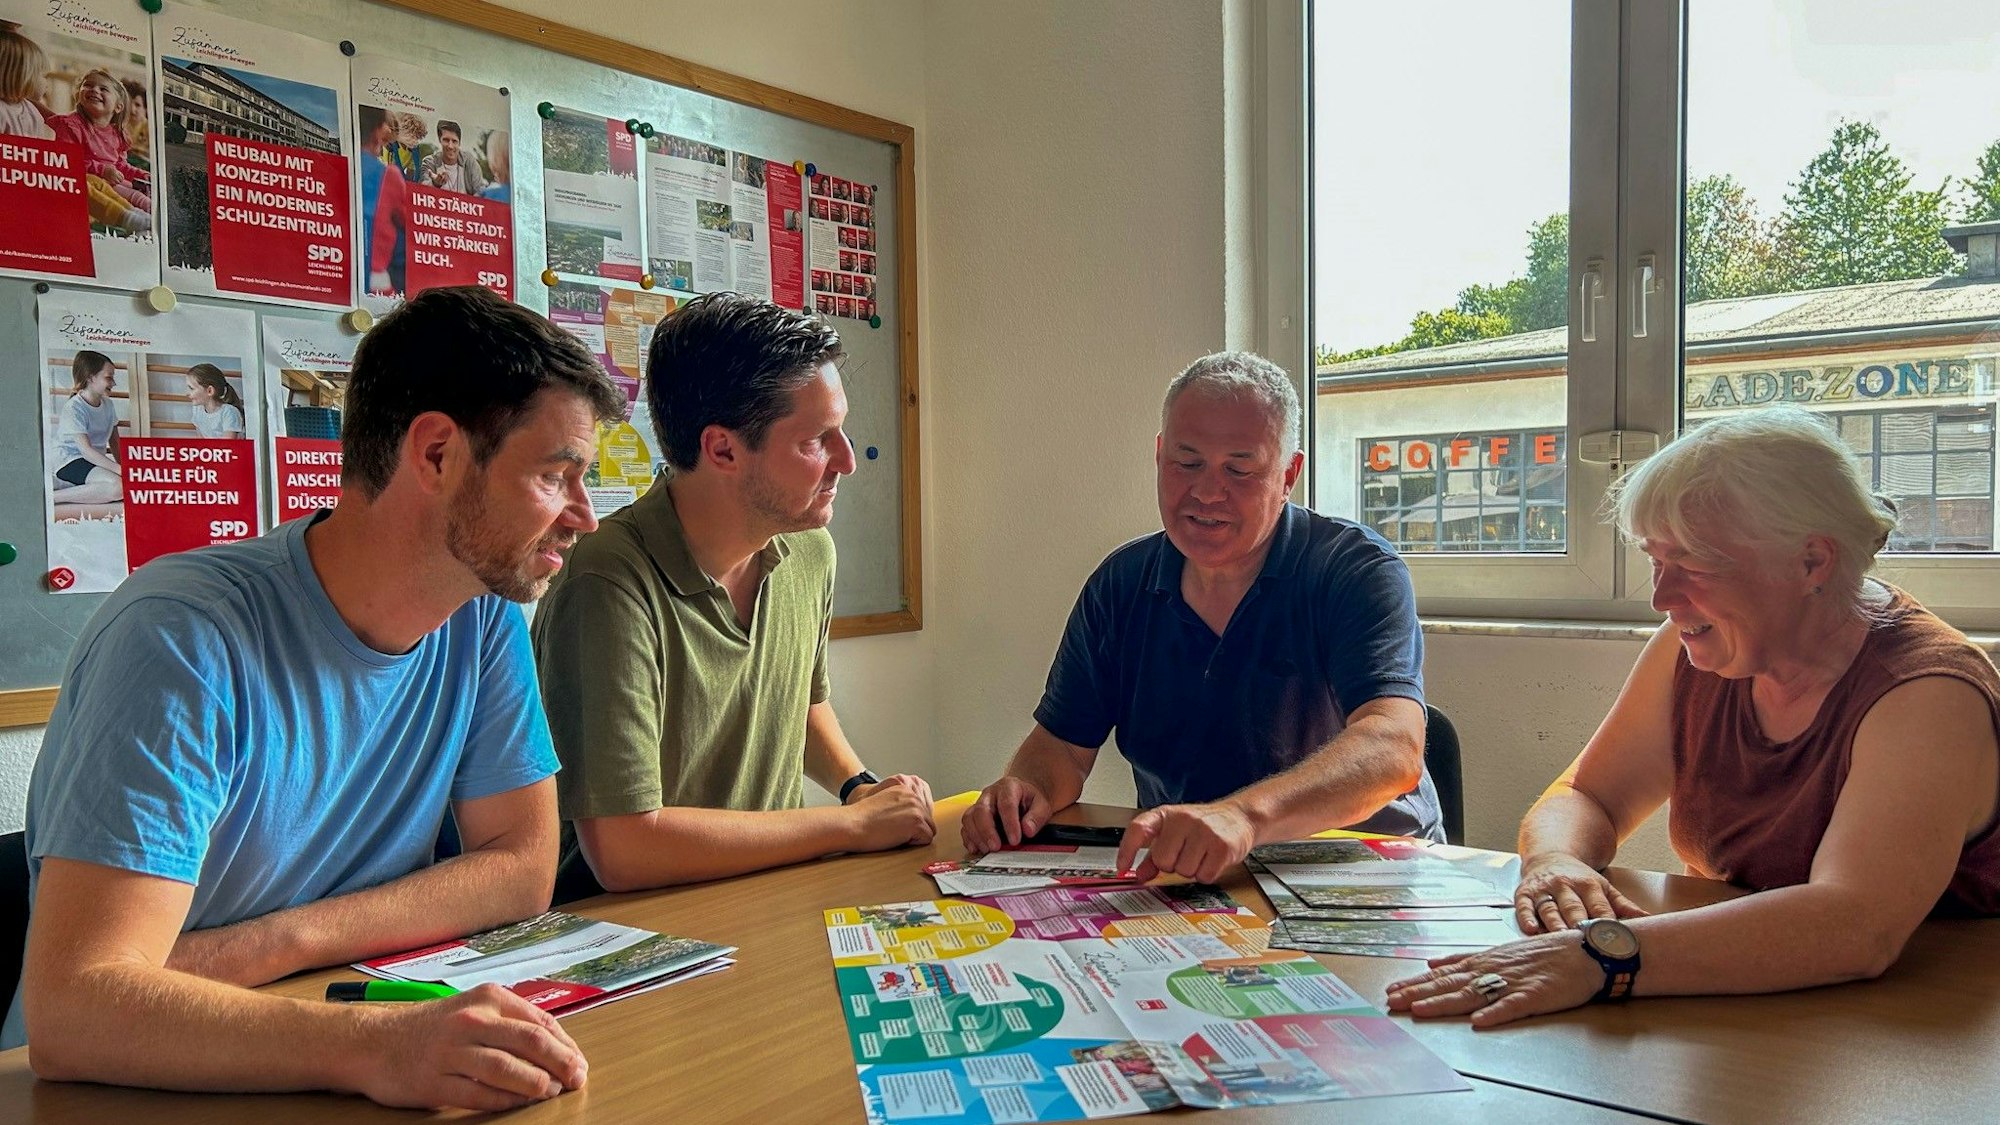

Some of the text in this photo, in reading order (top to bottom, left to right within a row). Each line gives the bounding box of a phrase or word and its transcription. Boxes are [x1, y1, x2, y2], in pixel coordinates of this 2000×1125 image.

[47, 0, 120, 30] Zusammen
[73, 21, 138, 41] Leichlingen bewegen
[172, 27, 240, 56] Zusammen
[367, 77, 423, 102] Zusammen
[615, 131, 632, 143] SPD
[43, 150, 69, 169] IM
[214, 140, 315, 173] NEUBAU MIT
[0, 167, 81, 194] LPUNKT.
[215, 162, 326, 196] KONZEPT! FÜR
[215, 184, 335, 217] EIN MODERNES
[412, 192, 485, 217] IHR STÄRKT
[216, 206, 343, 239] SCHULZENTRUM
[413, 212, 507, 239] UNSERE STADT.
[413, 231, 499, 256] WIR STÄRKEN
[307, 244, 344, 264] SPD
[414, 250, 454, 268] EUCH.
[307, 262, 344, 272] LEICHLINGEN
[307, 269, 344, 279] WITZHELDEN
[477, 270, 508, 288] SPD
[59, 314, 134, 337] Zusammen
[86, 334, 151, 346] Leichlingen bewegen
[281, 340, 341, 359] Zusammen
[332, 359, 353, 367] bewege
[128, 445, 239, 463] NEUE SPORT-
[129, 466, 218, 484] HALLE FÜR
[130, 489, 240, 505] WITZHELDEN
[209, 520, 249, 538] SPD
